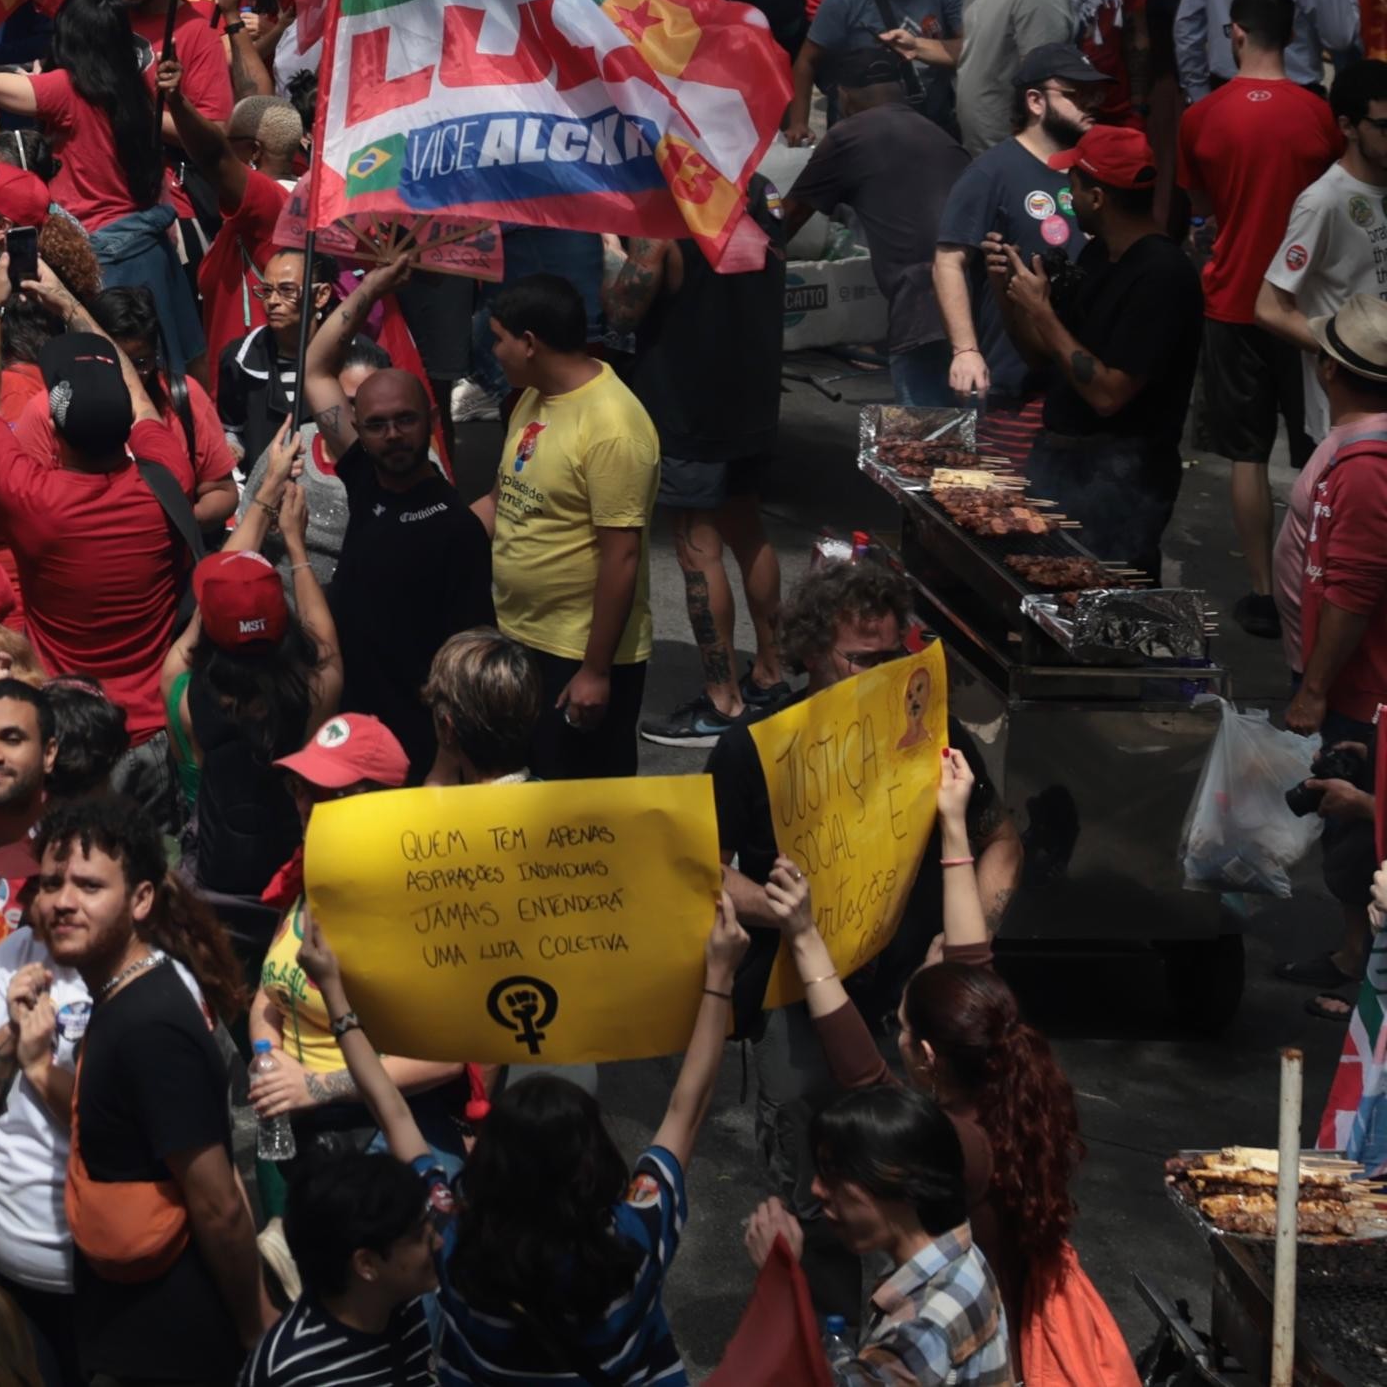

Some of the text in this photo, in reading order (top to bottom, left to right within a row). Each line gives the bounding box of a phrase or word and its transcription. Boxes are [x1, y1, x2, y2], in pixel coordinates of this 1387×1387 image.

[409, 119, 480, 182] VICE
[238, 618, 267, 633] MST
[775, 712, 881, 828] JUSTIÇA
[400, 824, 615, 862] QUEM TEM APENAS
[792, 773, 909, 877] SOCIAL É
[406, 863, 506, 892] ASPIRAÇÕES
[517, 887, 626, 923] ENTENDERÁ
[421, 932, 629, 969] UMA LUTA COLETIVA
